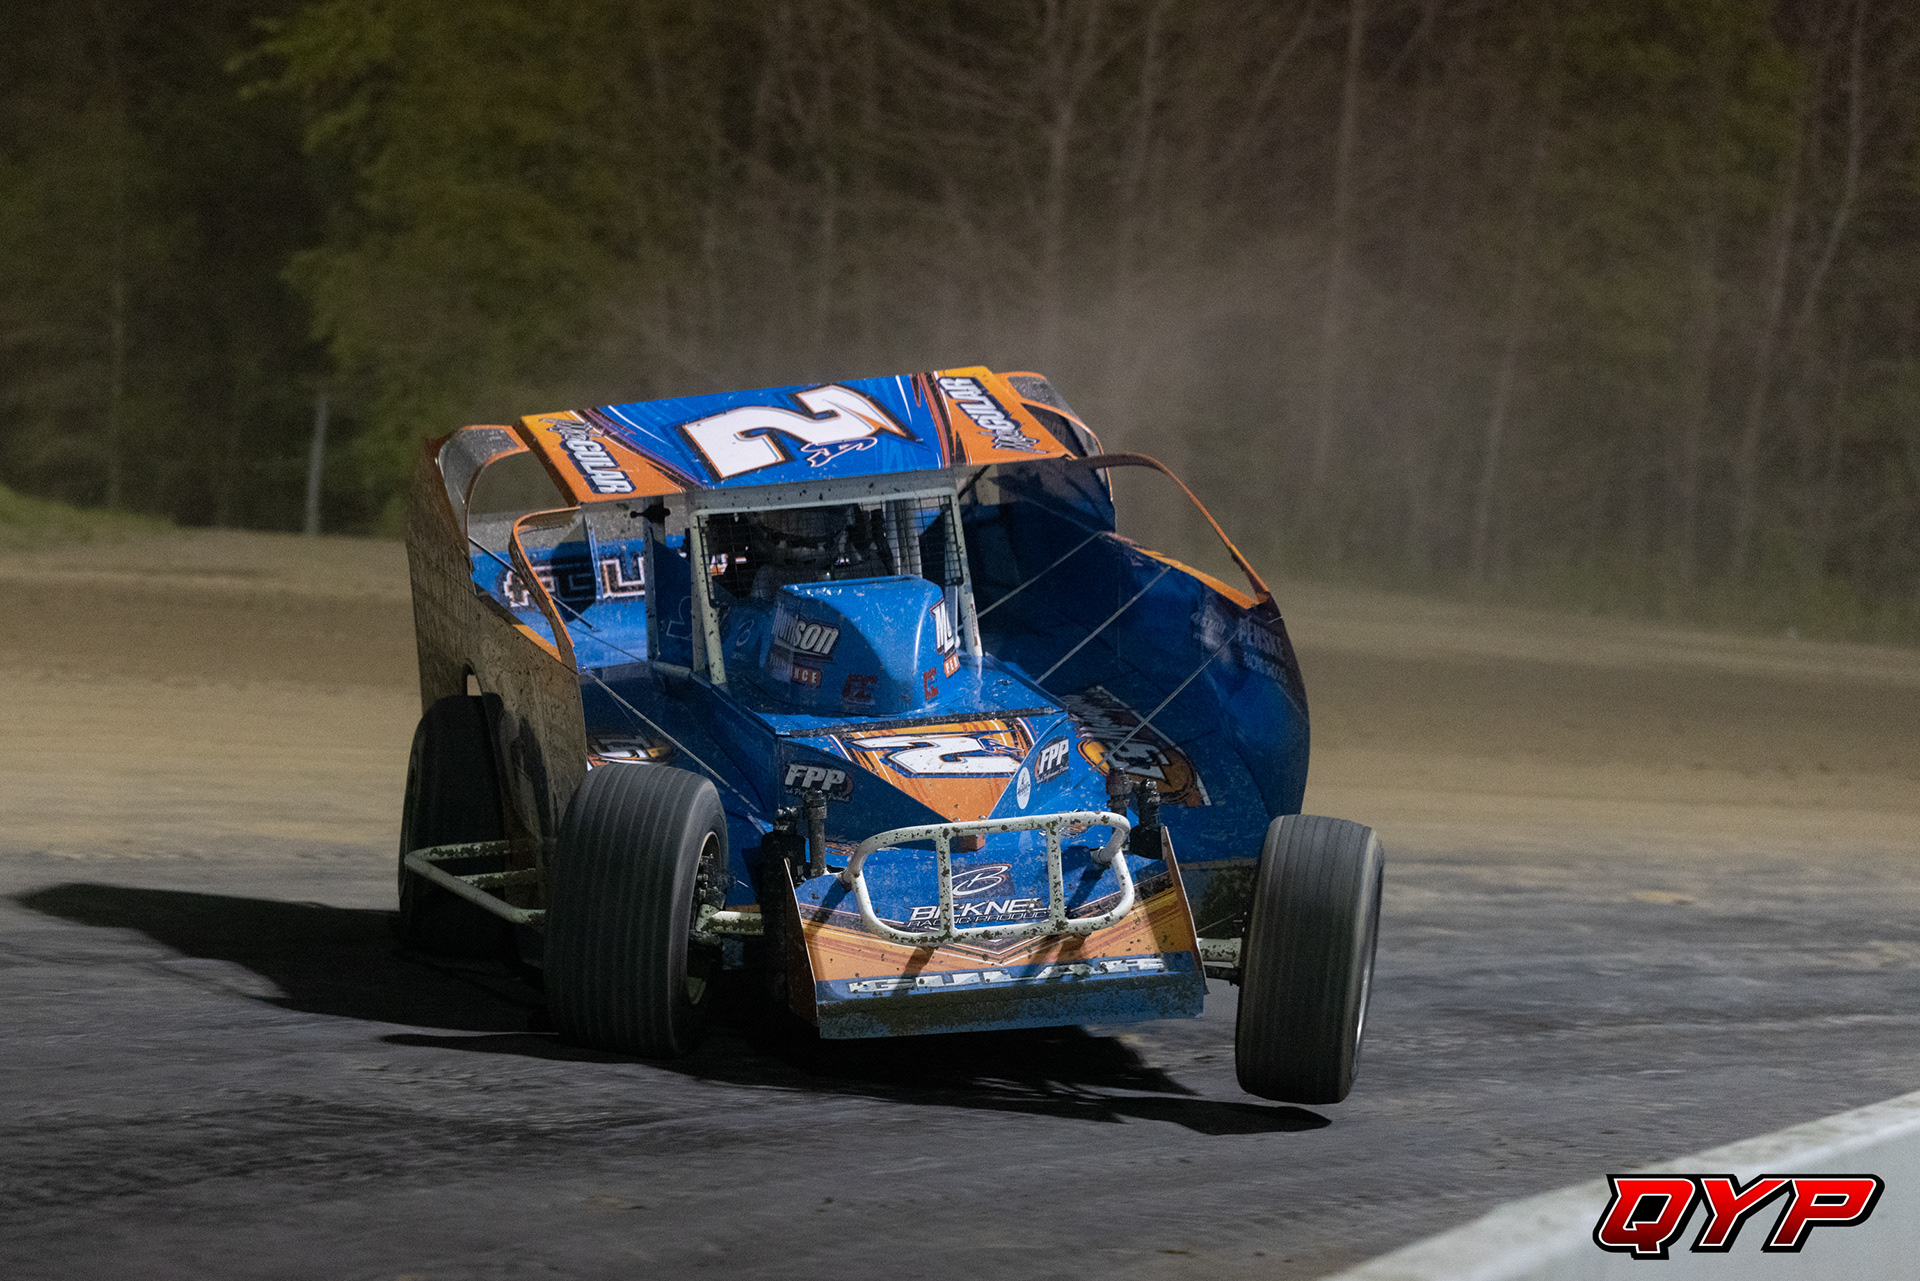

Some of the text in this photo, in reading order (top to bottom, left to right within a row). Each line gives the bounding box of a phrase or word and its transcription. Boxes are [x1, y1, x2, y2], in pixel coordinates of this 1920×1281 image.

[938, 378, 1017, 431] GULAR
[682, 384, 907, 479] 2
[562, 440, 635, 494] GULAR
[850, 733, 1022, 774] 2
[1039, 739, 1069, 775] FPP
[785, 764, 846, 791] FPP
